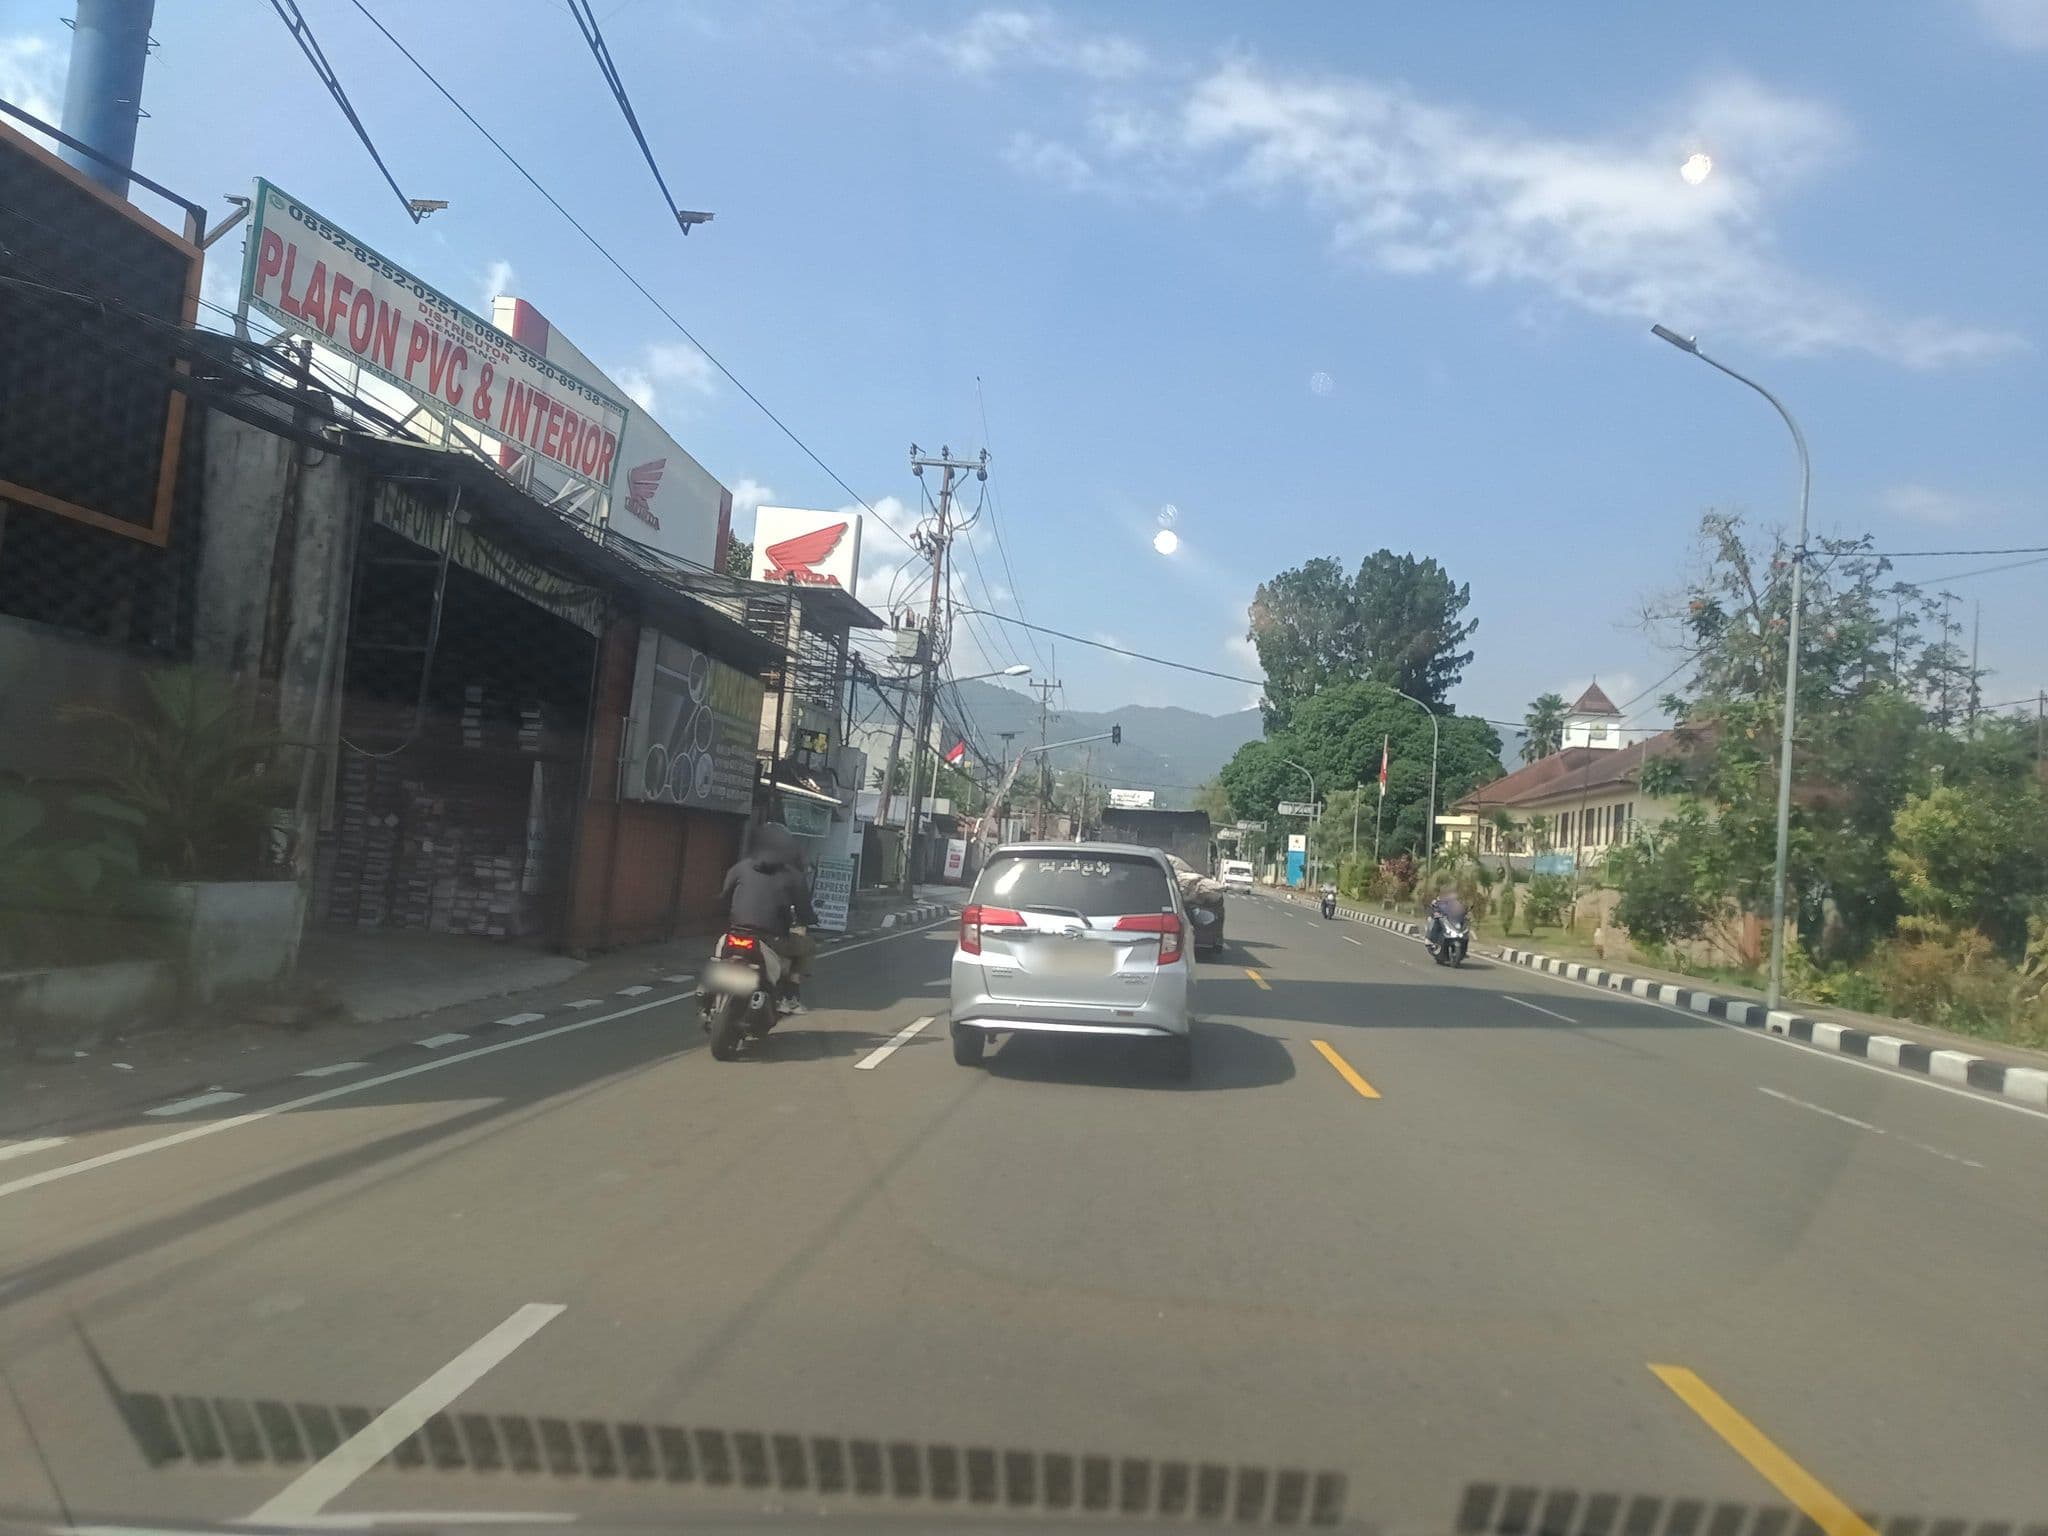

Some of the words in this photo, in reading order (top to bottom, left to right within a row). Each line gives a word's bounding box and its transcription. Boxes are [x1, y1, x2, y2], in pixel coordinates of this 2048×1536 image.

[288, 205, 458, 320] 0852-8252-0251
[474, 322, 600, 406] 0895-3520-89138
[417, 301, 510, 365] DISTRIBUTOR
[255, 227, 401, 371] PLAFON
[404, 320, 467, 407] PVC
[473, 362, 494, 422] &
[499, 376, 617, 486] INTERIOR
[424, 317, 497, 364] GEMILANG
[815, 880, 849, 894] EXPRESS
